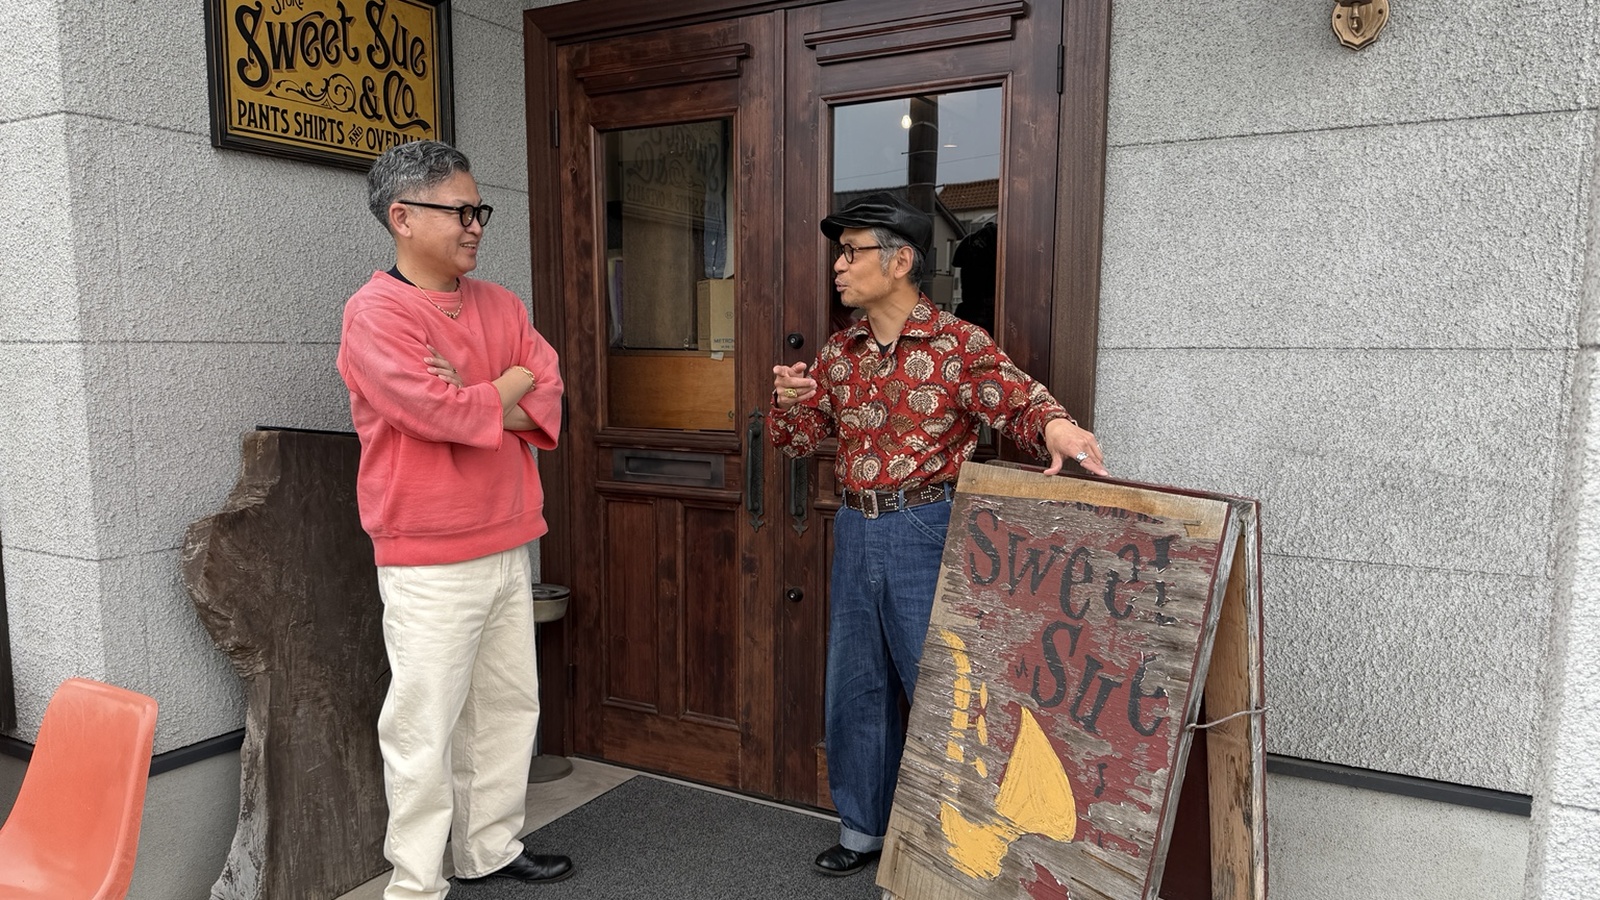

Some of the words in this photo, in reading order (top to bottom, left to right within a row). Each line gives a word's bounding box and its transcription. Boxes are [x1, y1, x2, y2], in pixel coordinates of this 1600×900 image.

[235, 0, 360, 88] Sweet
[365, 0, 427, 78] Sue
[237, 99, 290, 134] PANTS
[294, 112, 345, 145] SHIRTS
[348, 125, 364, 146] AND
[967, 507, 1180, 626] Sweet
[1031, 620, 1169, 737] Sue
